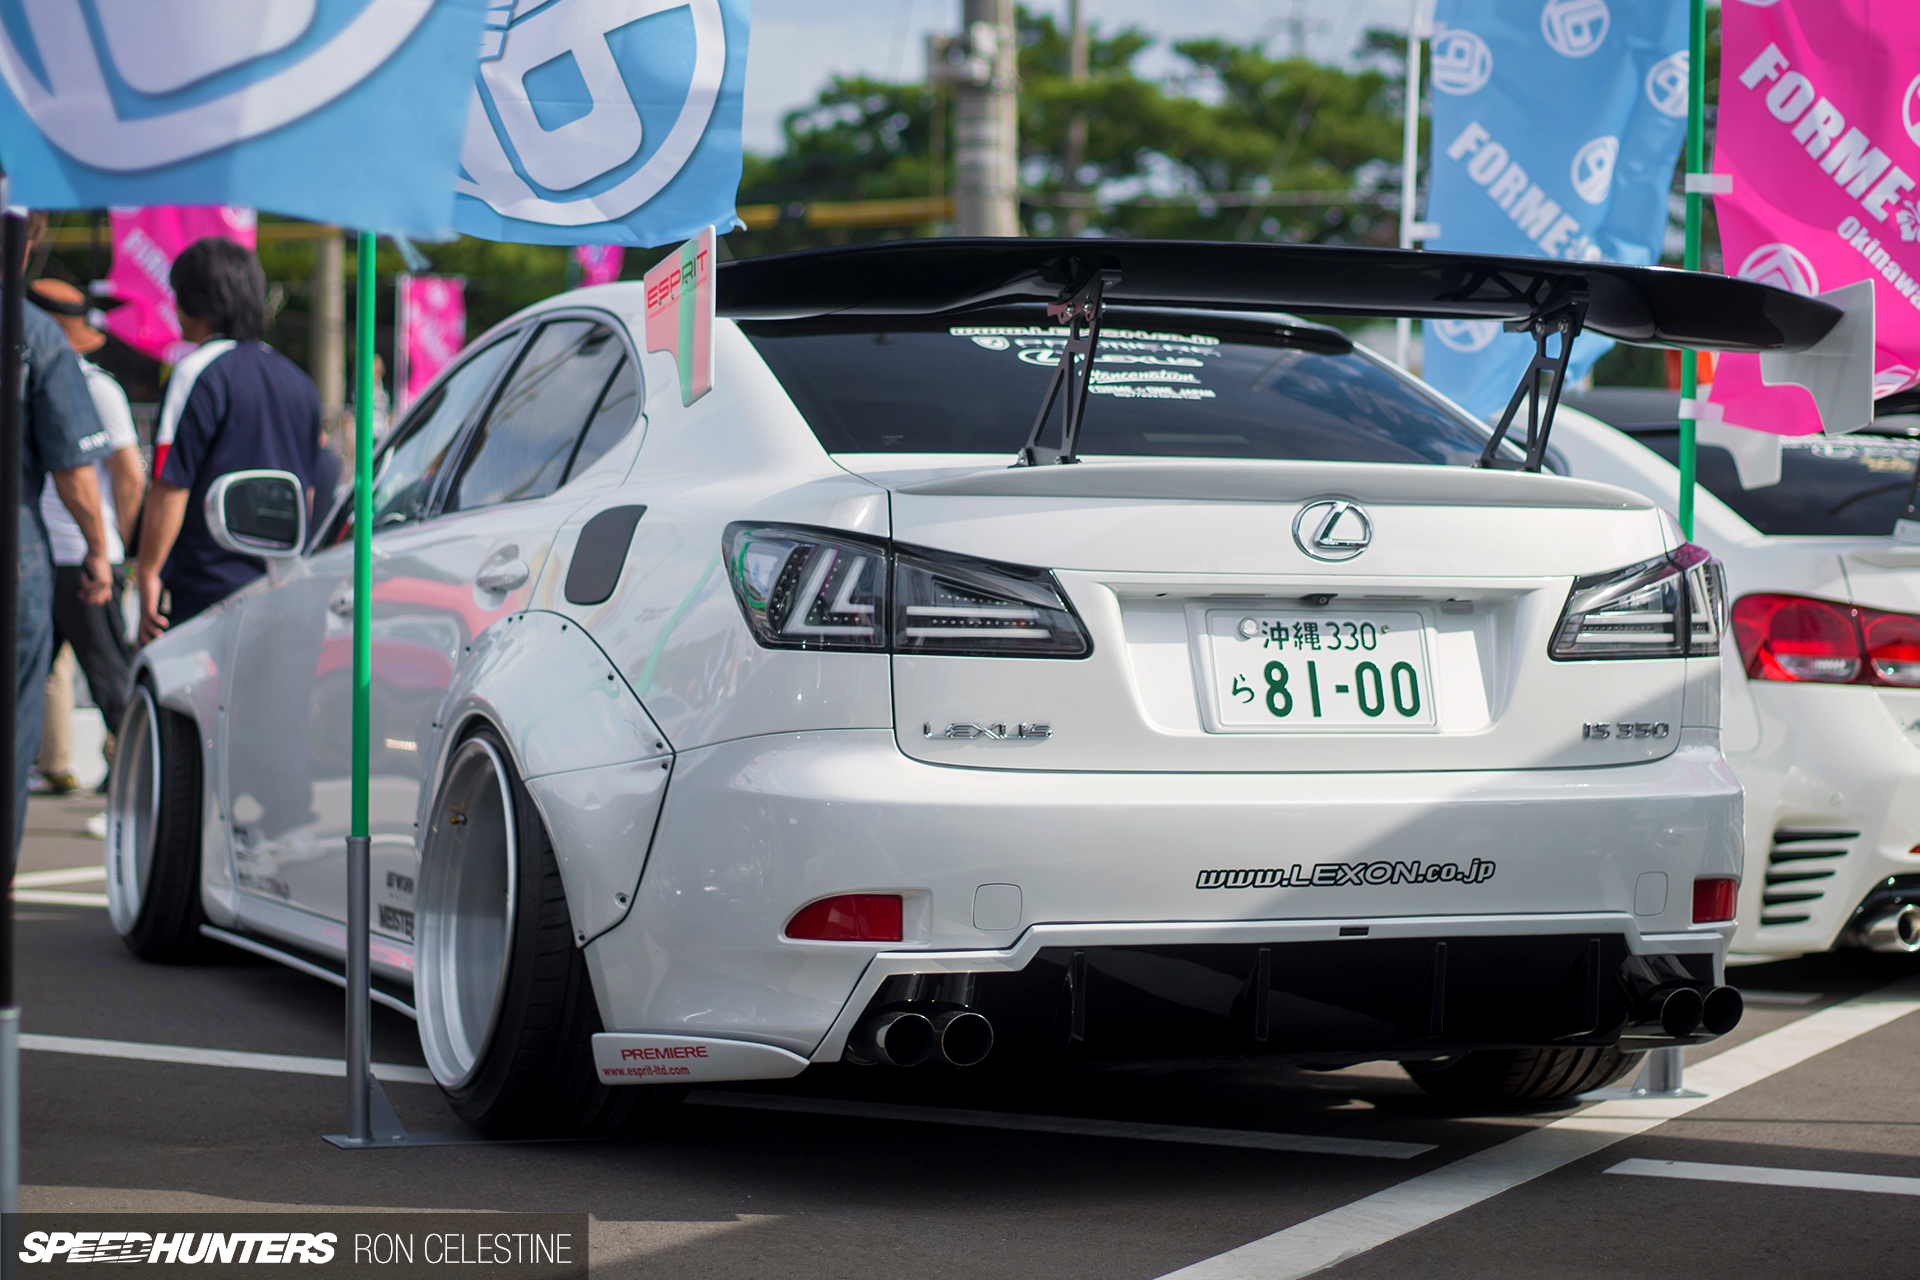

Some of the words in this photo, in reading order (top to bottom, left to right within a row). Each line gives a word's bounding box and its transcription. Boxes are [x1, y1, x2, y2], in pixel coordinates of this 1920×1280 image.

[1739, 42, 1916, 224] FORME
[1447, 120, 1580, 258] FORME
[647, 249, 708, 310] ESPRIT
[1261, 620, 1321, 650] 沖縄
[1325, 621, 1377, 651] 330
[1231, 673, 1255, 704] ら
[1263, 660, 1421, 718] 81-00
[923, 721, 1053, 740] LEXUS
[1582, 720, 1611, 740] IS
[1615, 720, 1670, 740] 350
[1196, 857, 1496, 890] www.LEXON.co.jp
[620, 1045, 709, 1061] PREMIERE
[602, 1064, 691, 1079] www.esprit-ltd.com
